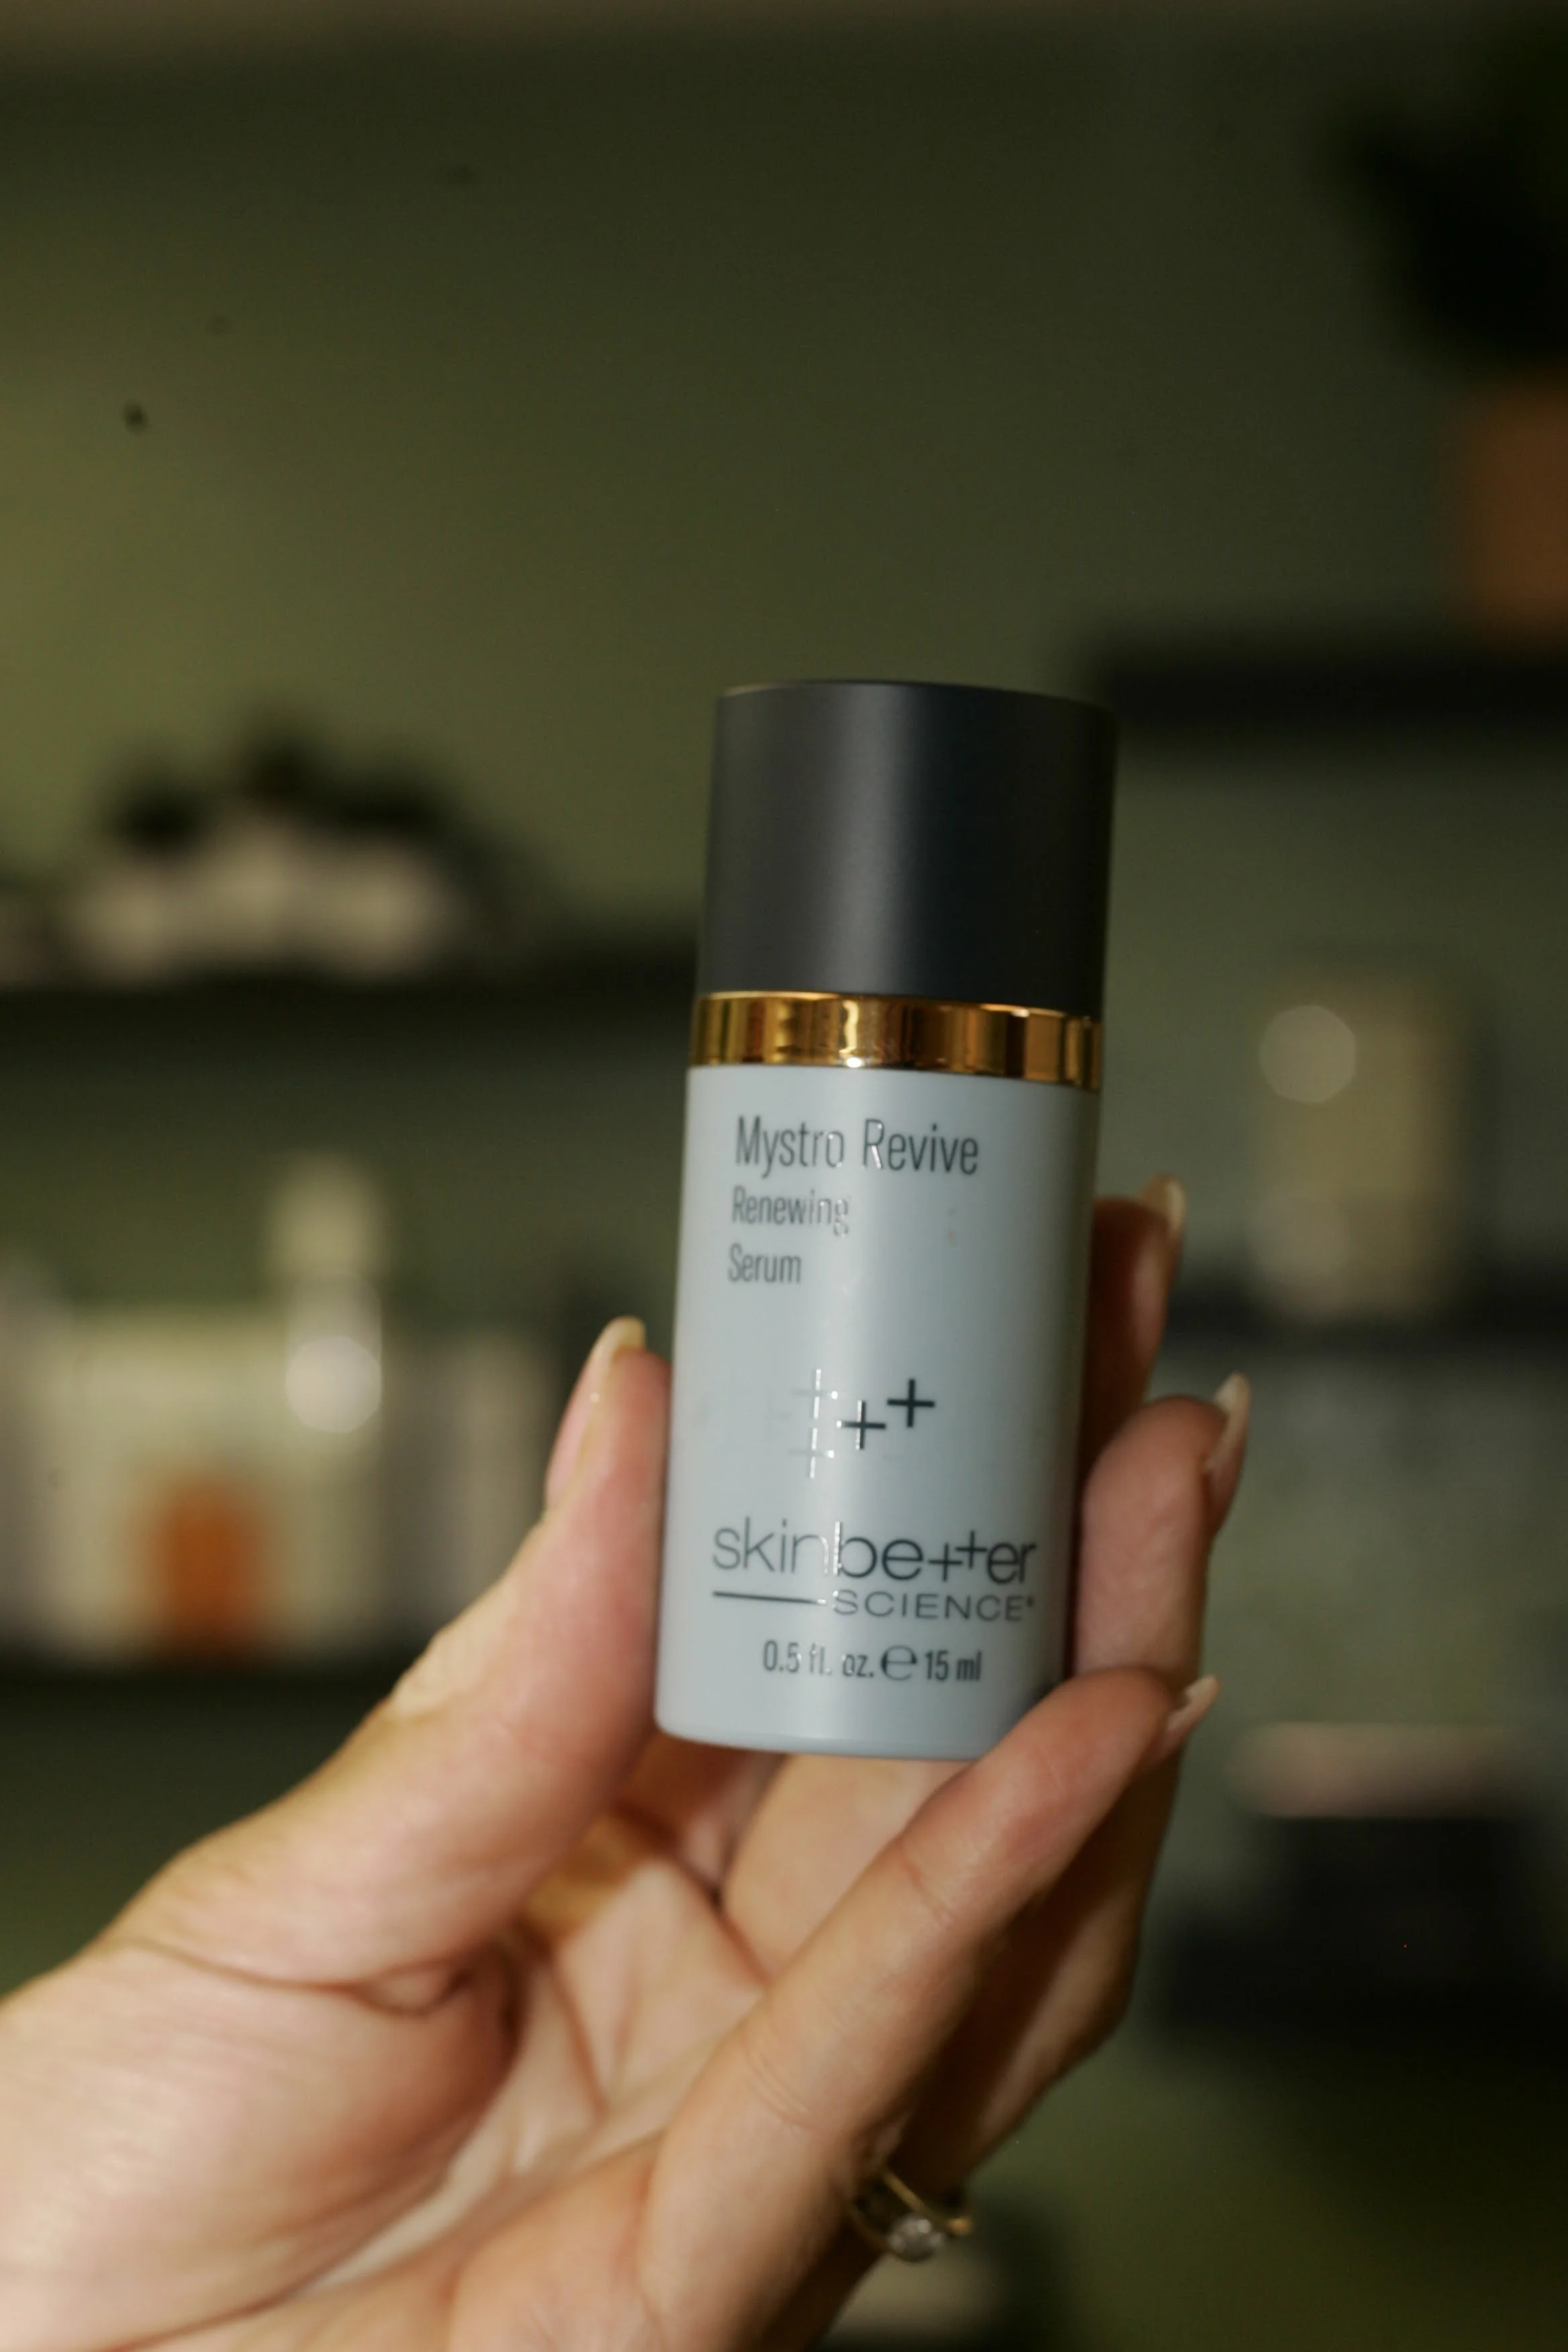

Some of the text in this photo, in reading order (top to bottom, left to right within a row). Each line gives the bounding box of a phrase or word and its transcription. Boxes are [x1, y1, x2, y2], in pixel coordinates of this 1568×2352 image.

[735, 1115, 979, 1179] Mystro Revive
[732, 1184, 849, 1238] Renewing
[728, 1242, 801, 1283] Serum
[762, 1640, 801, 1673] 0.5
[809, 1644, 832, 1675] fl.
[841, 1654, 874, 1679] oz.
[925, 1650, 950, 1681] 15
[956, 1651, 983, 1681] ml
